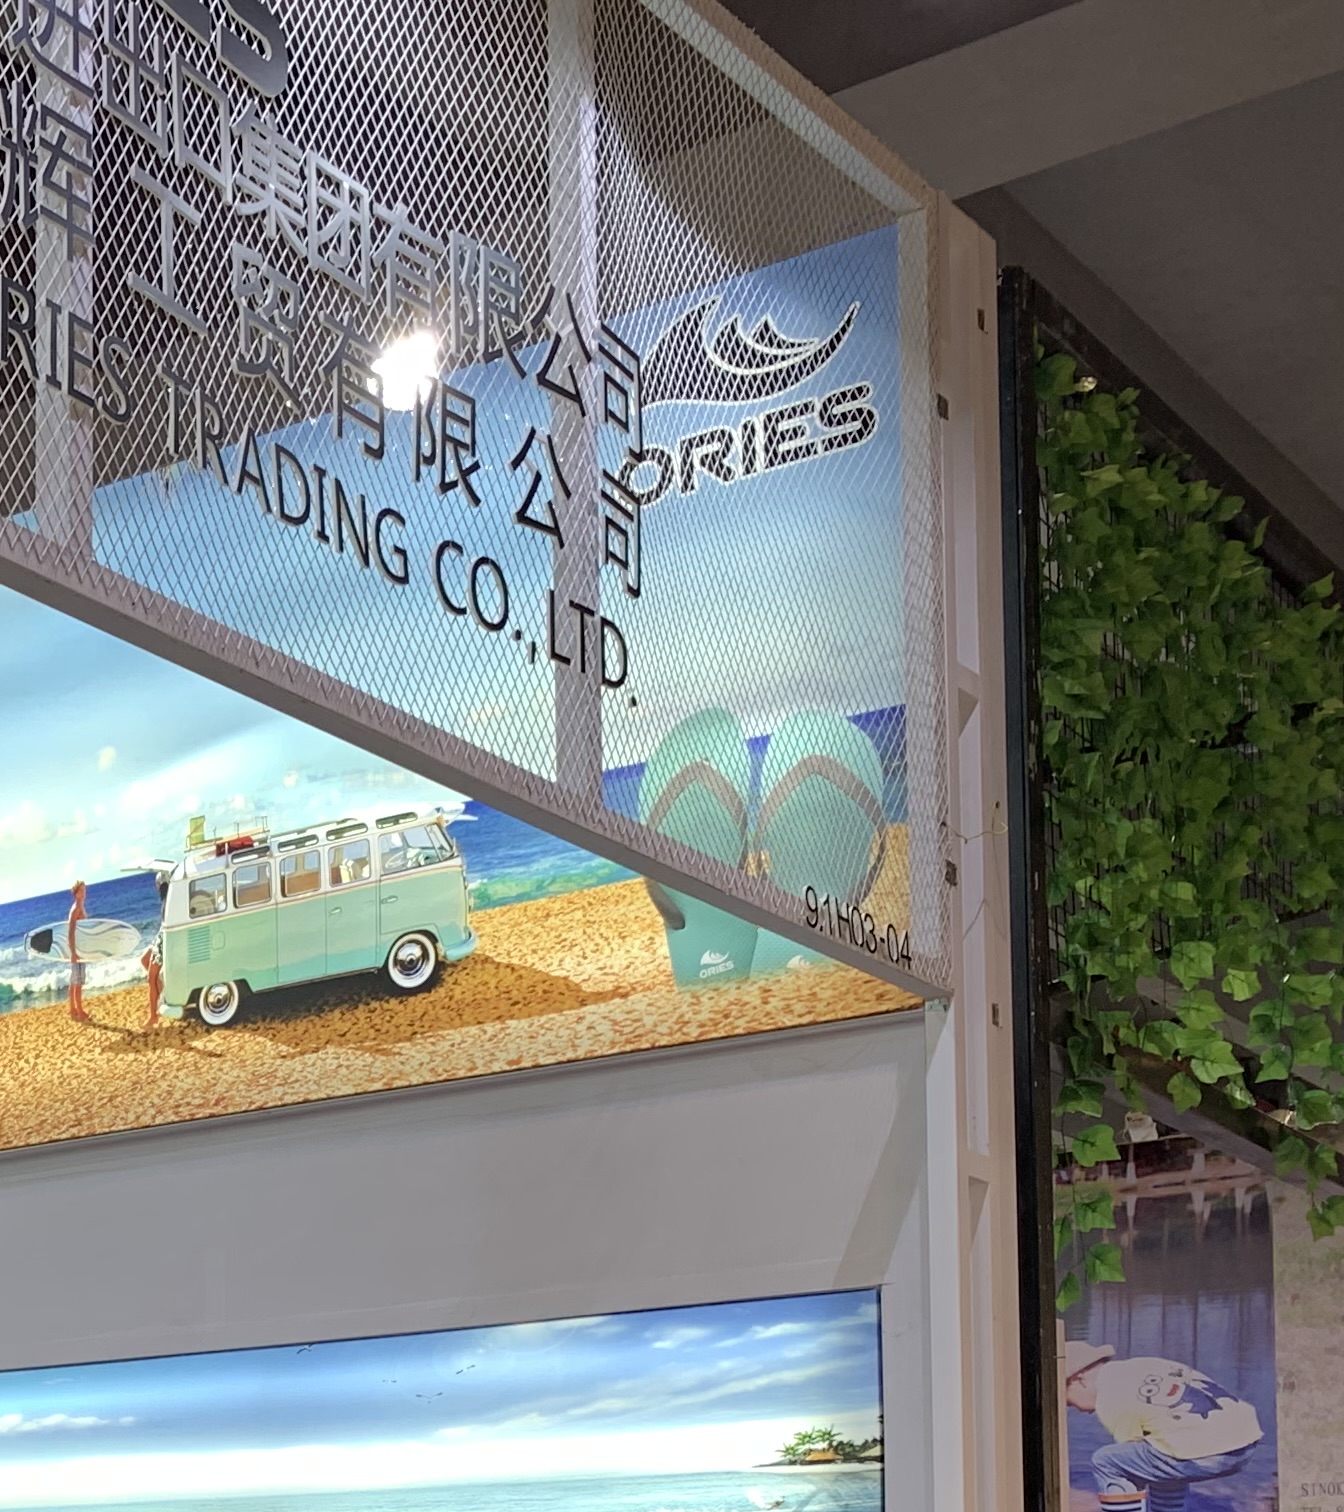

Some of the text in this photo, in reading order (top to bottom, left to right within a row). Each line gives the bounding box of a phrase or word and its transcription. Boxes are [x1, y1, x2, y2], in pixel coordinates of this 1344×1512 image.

[158, 362, 410, 586] TRADING
[616, 380, 880, 512] ORIES
[699, 960, 735, 979] ORIES
[803, 884, 912, 971] 9.1H03-04
